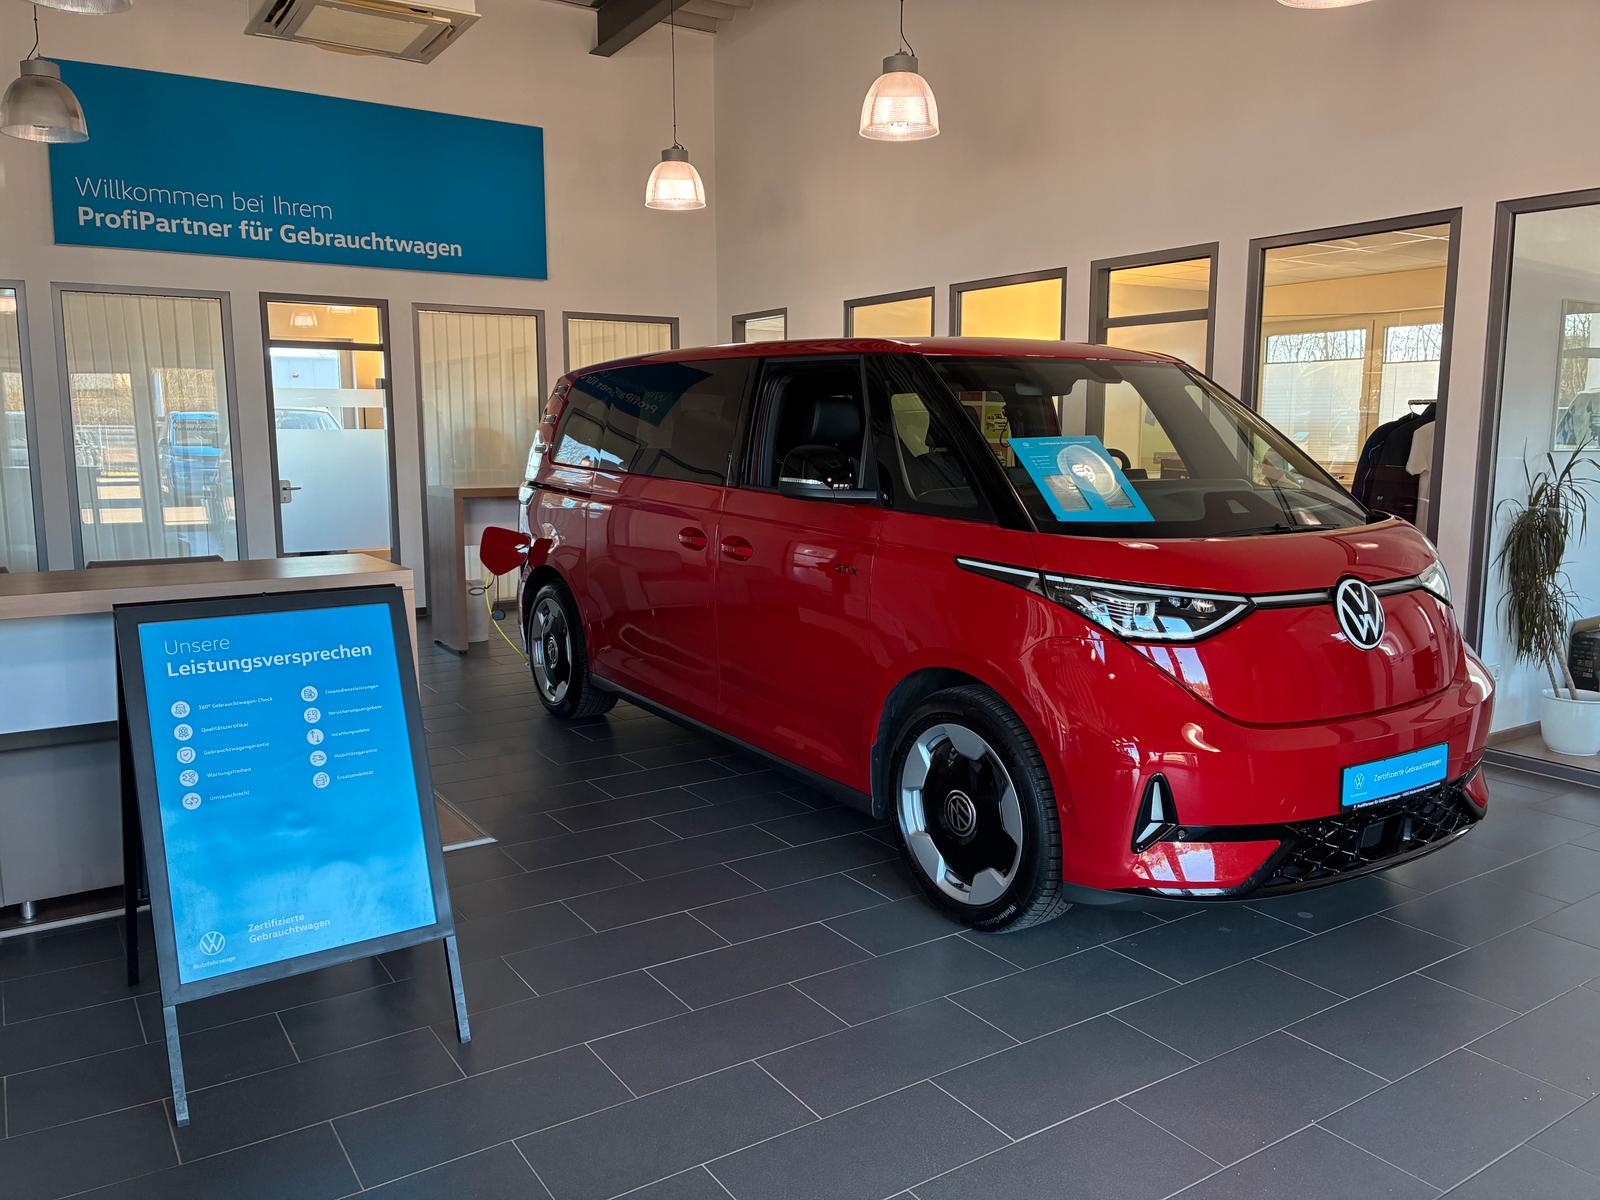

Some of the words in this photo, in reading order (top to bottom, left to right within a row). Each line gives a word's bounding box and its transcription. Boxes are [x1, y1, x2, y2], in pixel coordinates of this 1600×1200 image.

[74, 175, 224, 209] Willkommen
[231, 191, 265, 213] bei
[273, 195, 333, 221] Ihrem
[77, 205, 232, 239] ProfiPartner
[238, 219, 273, 243] für
[279, 224, 463, 260] Gebrauchtwagen
[164, 637, 231, 656] Unsere
[166, 644, 373, 678] Leistungsversprechen
[1374, 769, 1404, 781] Zertifizierte
[248, 914, 305, 932] Zertifizierte
[248, 918, 331, 944] Gebrauchtwagen
